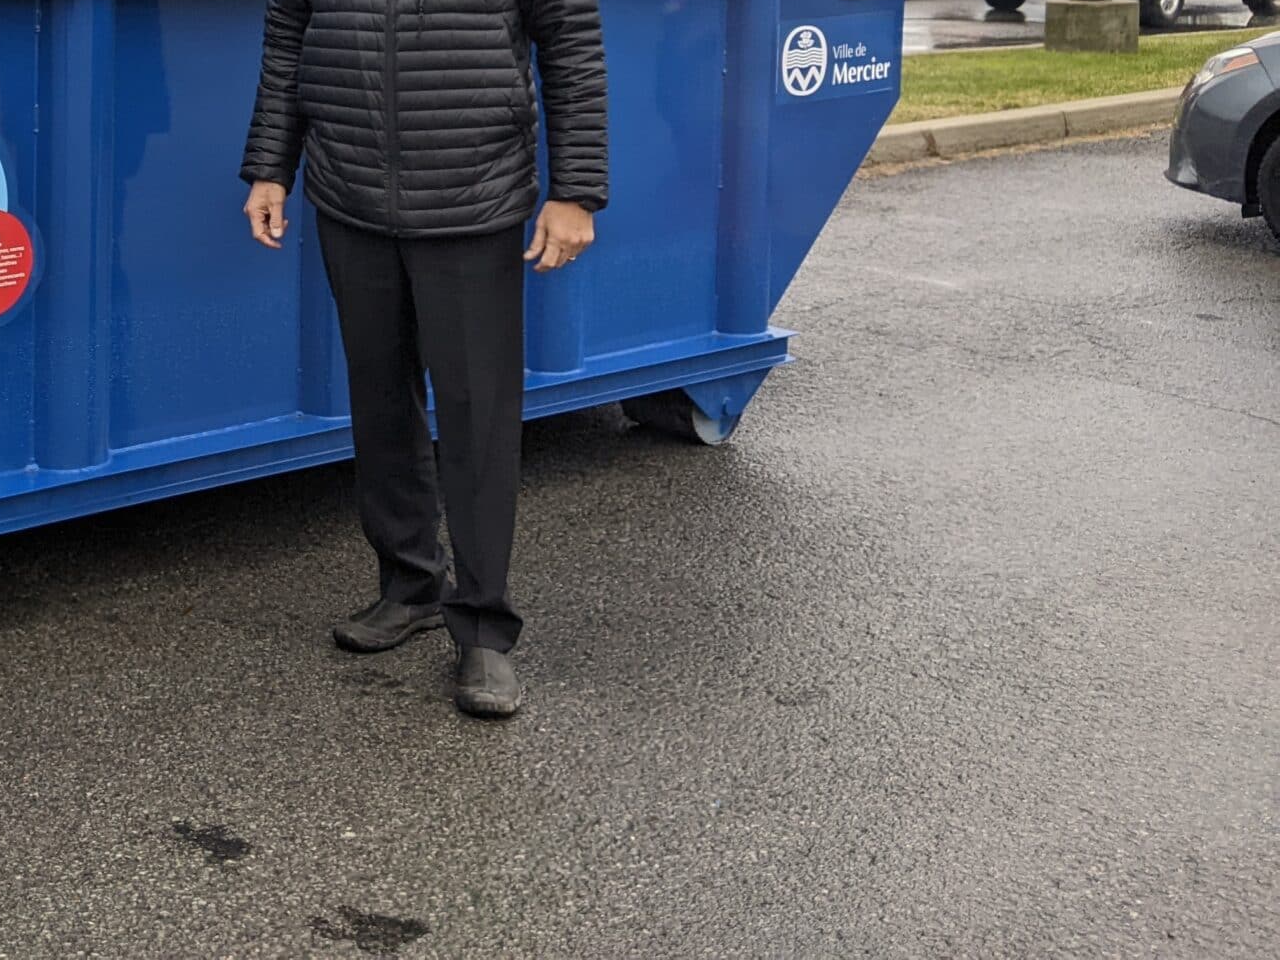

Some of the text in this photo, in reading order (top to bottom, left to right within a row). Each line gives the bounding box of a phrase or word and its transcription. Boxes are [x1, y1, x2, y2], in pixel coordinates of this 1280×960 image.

[832, 42, 867, 59] Ville de
[832, 56, 891, 85] Mercier
